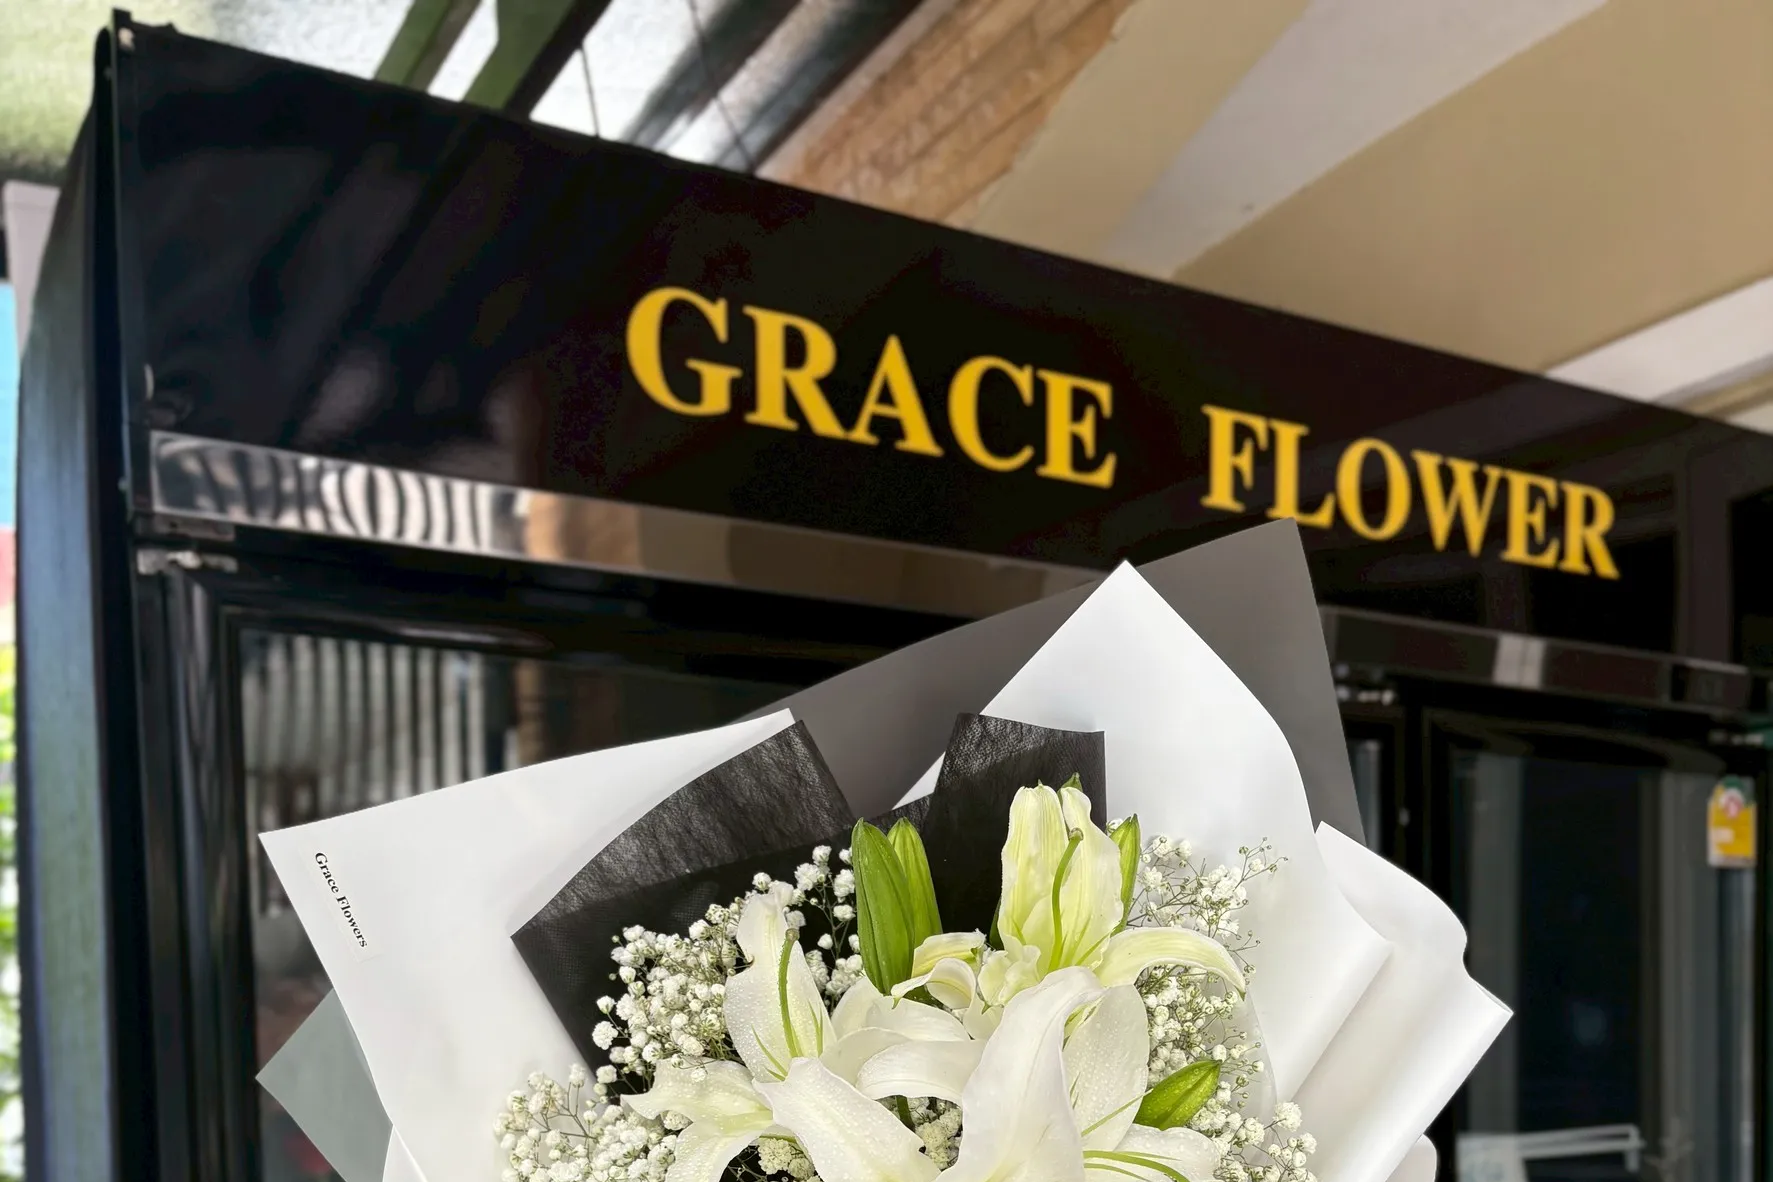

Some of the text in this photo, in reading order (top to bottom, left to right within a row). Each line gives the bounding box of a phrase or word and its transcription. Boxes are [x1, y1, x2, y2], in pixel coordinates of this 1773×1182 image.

[626, 286, 1620, 580] GRACE FLOWER
[315, 852, 368, 948] Grace Flowers
